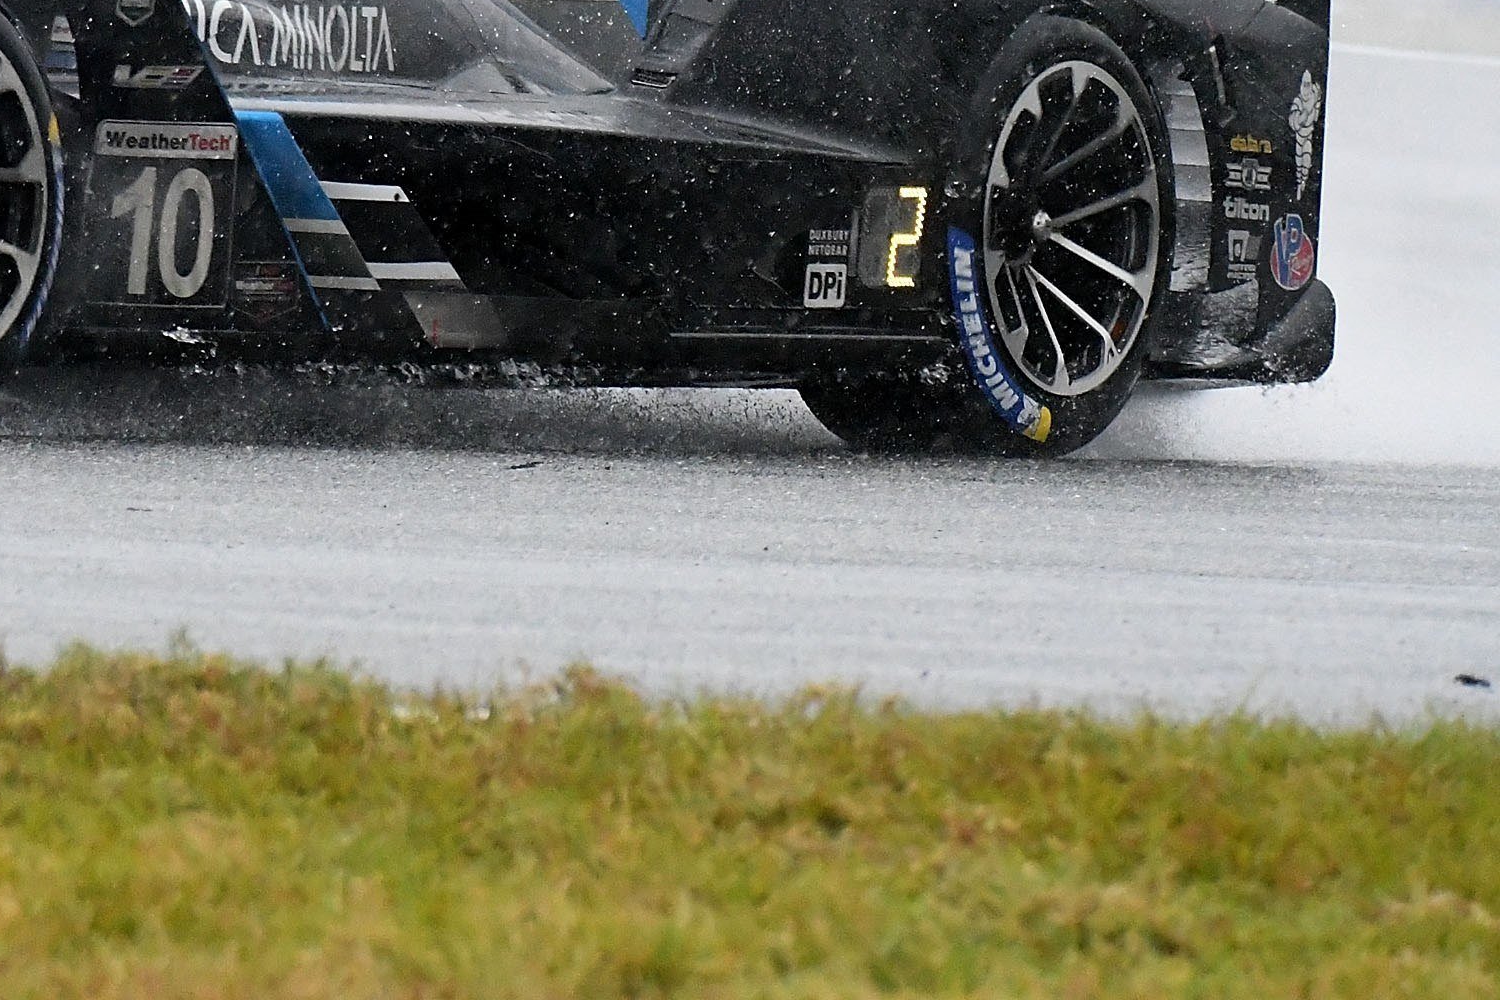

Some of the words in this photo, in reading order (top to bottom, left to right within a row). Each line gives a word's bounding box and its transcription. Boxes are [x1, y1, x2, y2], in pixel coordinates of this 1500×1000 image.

[267, 3, 395, 73] MINOLTA
[106, 131, 230, 151] WeatherTech
[111, 166, 214, 298] 10
[886, 186, 928, 287] 2
[808, 271, 843, 300] DPi
[954, 247, 1019, 410] MICHELIN
